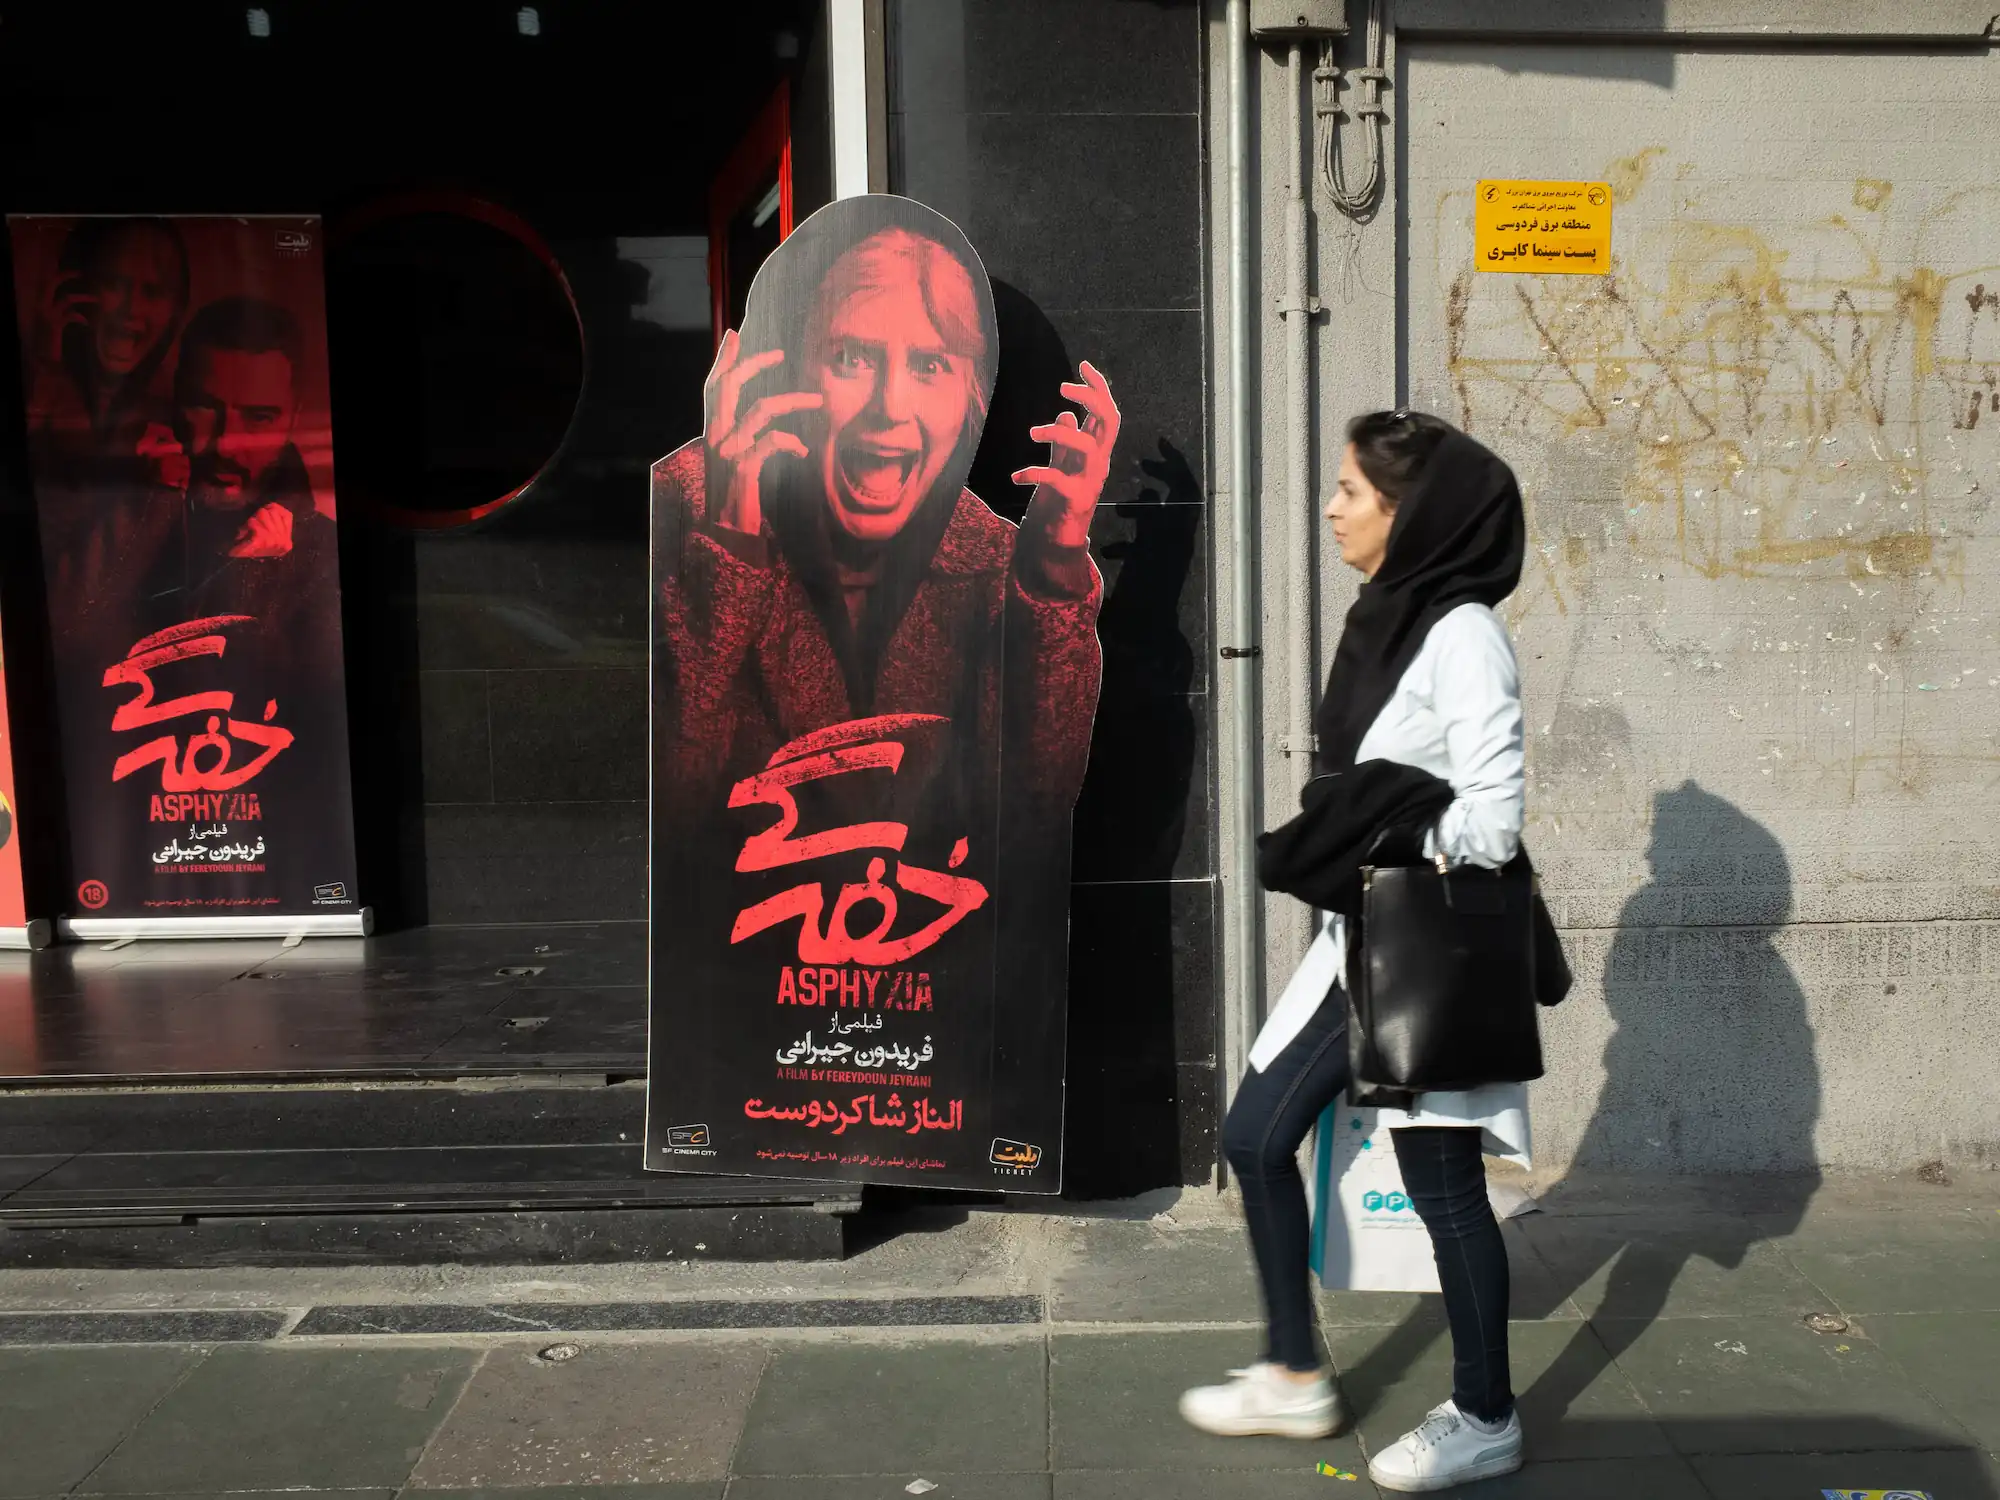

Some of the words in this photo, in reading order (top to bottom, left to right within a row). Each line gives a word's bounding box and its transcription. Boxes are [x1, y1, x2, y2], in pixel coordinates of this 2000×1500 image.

[1496, 217, 1538, 232] فردوسی
[1541, 219, 1559, 232] برق
[1562, 218, 1592, 230] منطقه
[1488, 243, 1529, 261] کاپری
[1533, 243, 1562, 261] سینما
[1564, 247, 1597, 263] پست
[150, 793, 262, 822] ASPHYXIA
[152, 838, 208, 863] جیرانی
[209, 835, 266, 861] فریدون
[85, 887, 101, 901] 18
[777, 966, 934, 1011] ASPHYXIA
[776, 1030, 854, 1064] جیرانی
[854, 1034, 934, 1071] فریدون
[777, 1067, 784, 1080] A
[786, 1068, 808, 1081] FILM
[811, 1069, 825, 1081] BY
[827, 1069, 887, 1085] FEREYDOUN
[889, 1073, 931, 1088] JEYRANI
[906, 1097, 963, 1134] الناز
[811, 1151, 828, 1162] سال
[887, 1158, 904, 1167] فیلم
[994, 1143, 1038, 1169] بلیت
[993, 1167, 1033, 1176] TICKET
